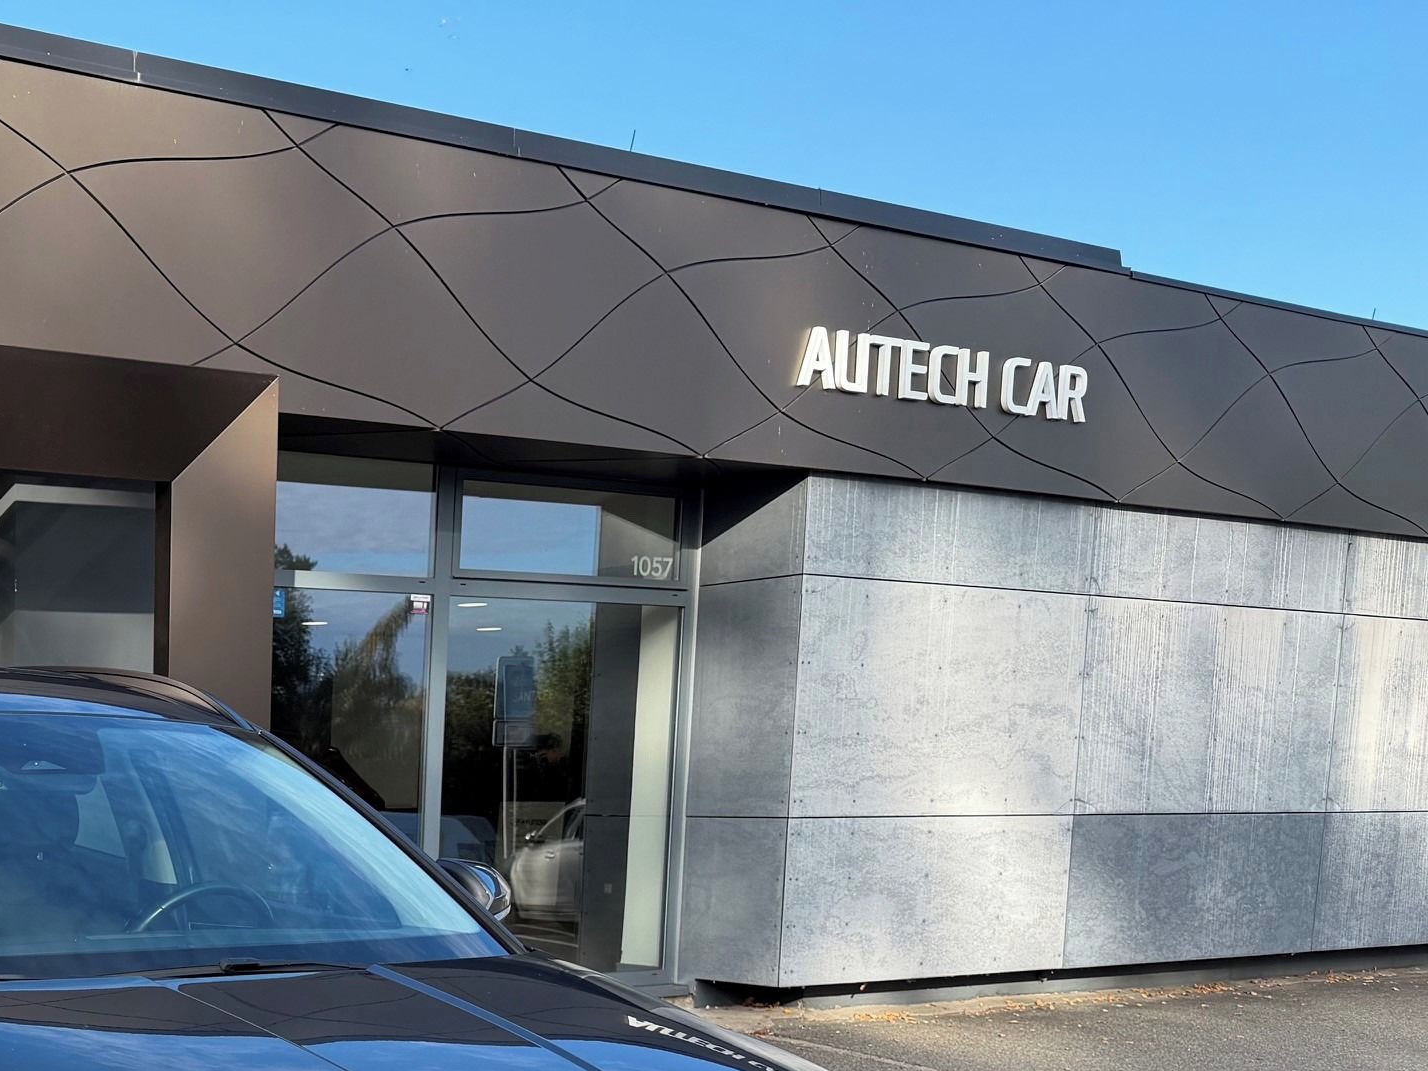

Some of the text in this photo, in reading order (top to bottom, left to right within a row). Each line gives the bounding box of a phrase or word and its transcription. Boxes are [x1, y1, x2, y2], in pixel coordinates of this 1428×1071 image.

[796, 326, 1088, 423] AUTECH CAR
[631, 555, 673, 578] 1057
